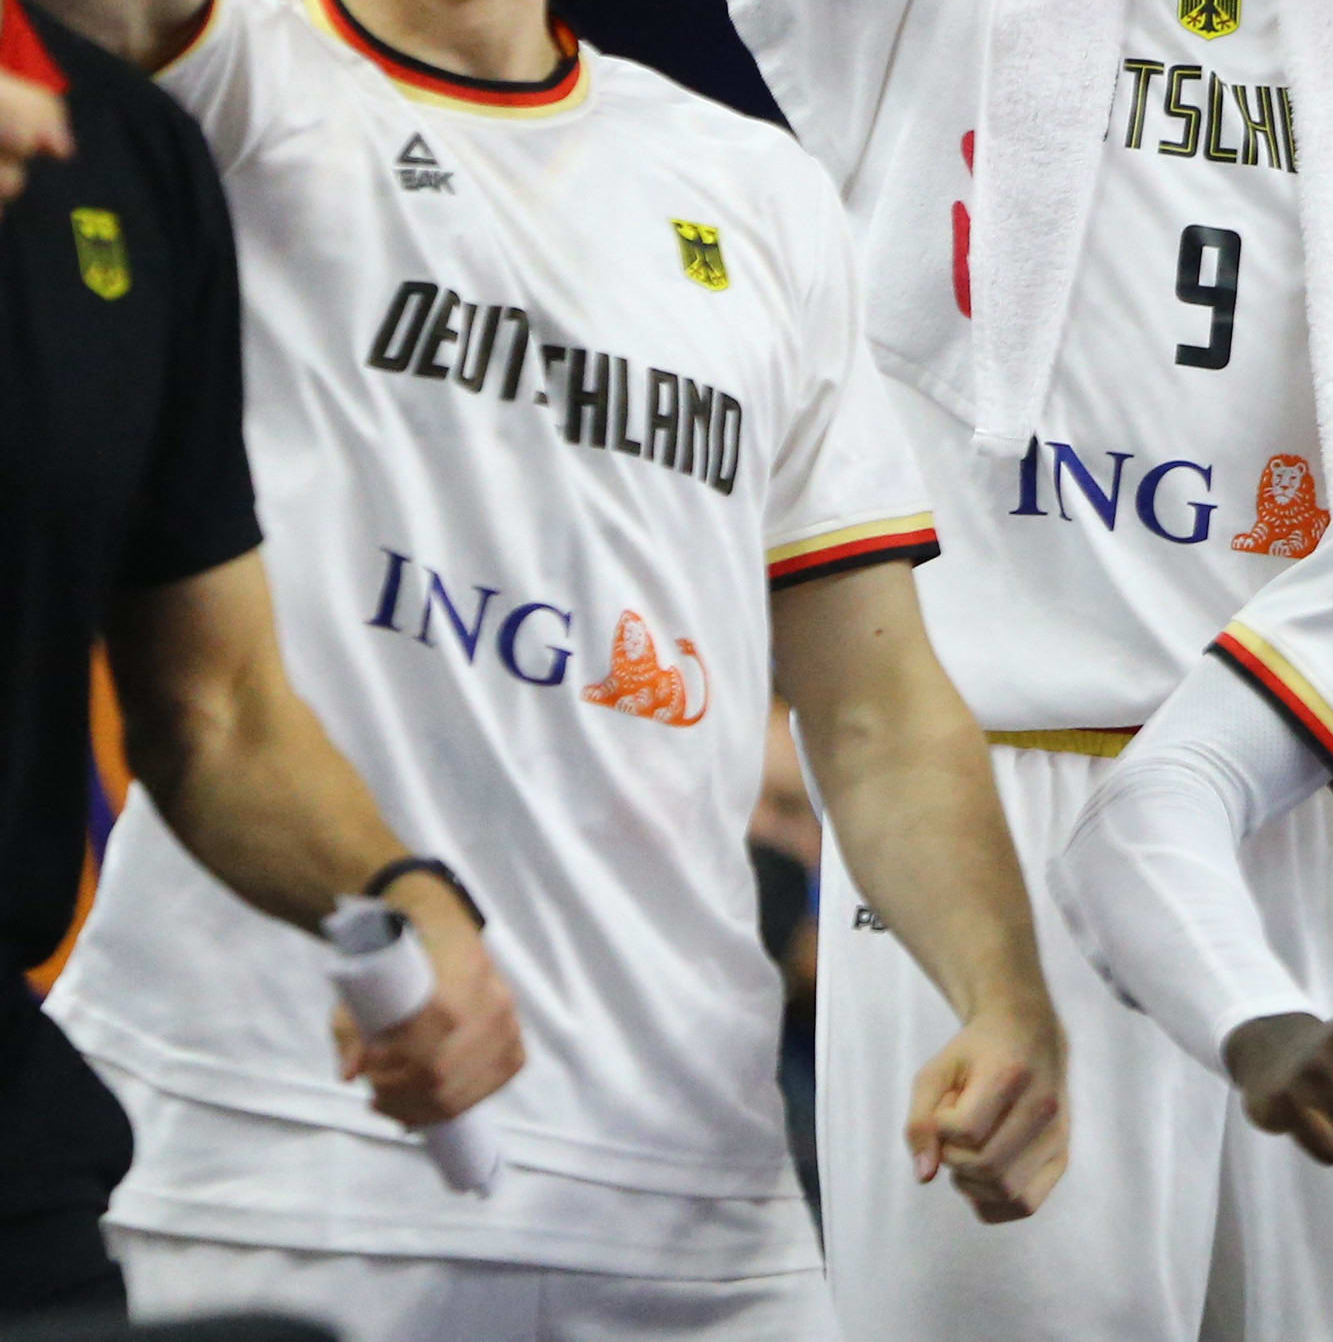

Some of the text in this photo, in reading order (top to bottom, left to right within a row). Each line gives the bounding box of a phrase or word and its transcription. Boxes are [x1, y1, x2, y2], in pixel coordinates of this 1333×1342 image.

[1103, 58, 1298, 174] TSCH
[1174, 224, 1242, 371] 9
[1008, 434, 1219, 546] ING
[367, 547, 574, 688] ING
